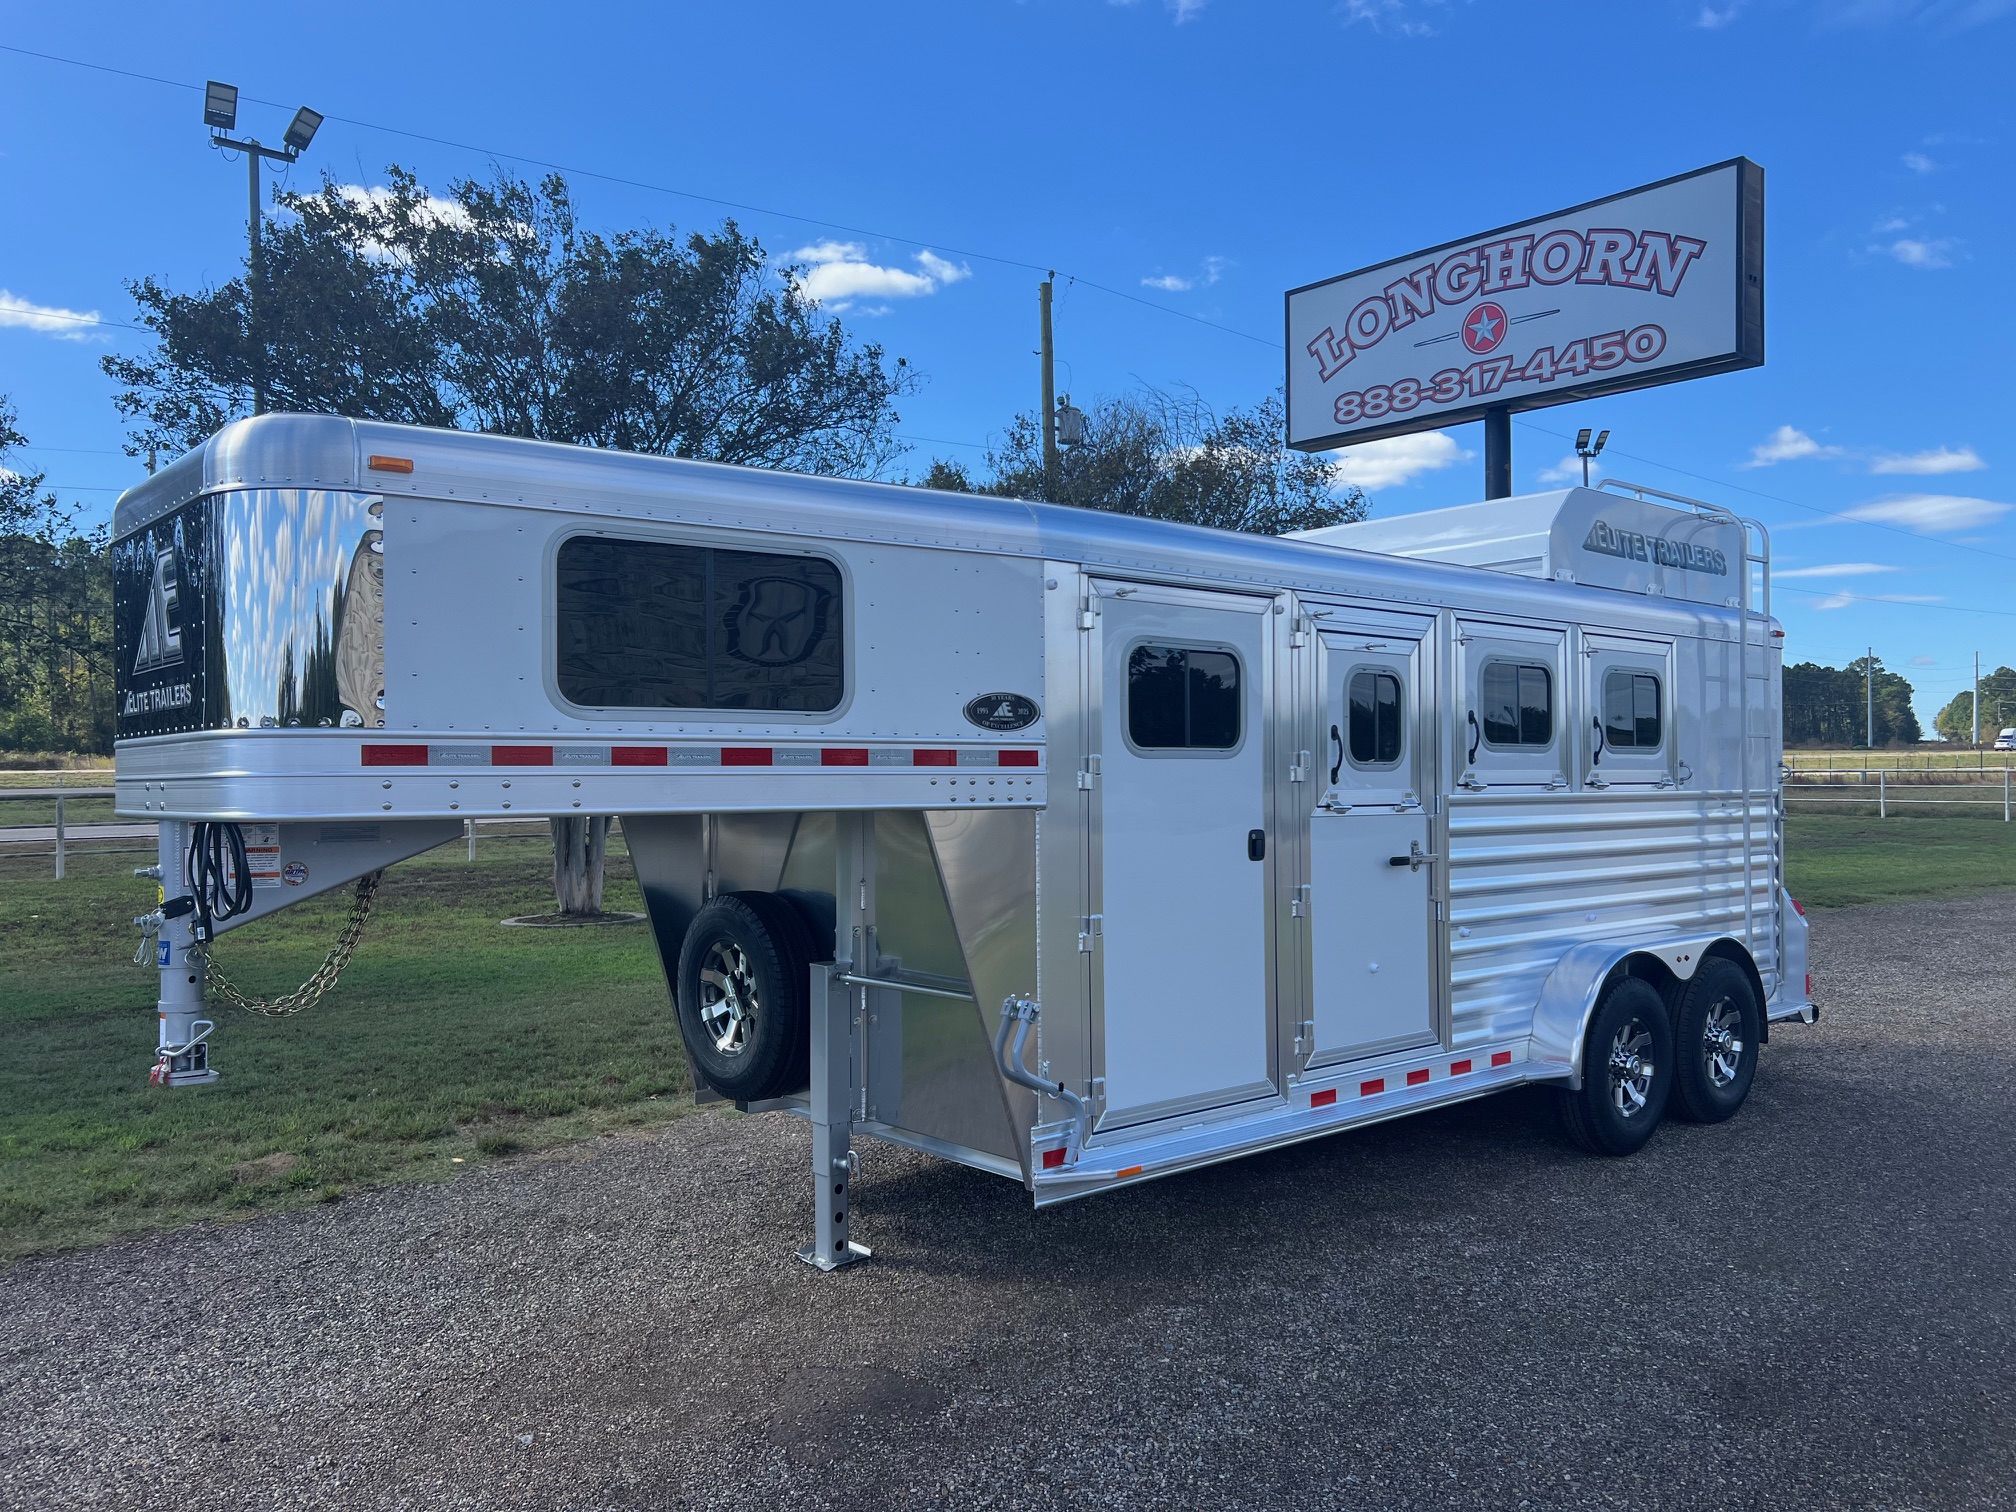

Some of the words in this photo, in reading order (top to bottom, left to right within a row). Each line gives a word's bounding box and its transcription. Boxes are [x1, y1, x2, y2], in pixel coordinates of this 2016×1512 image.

[1307, 228, 1707, 383] LONGHORN
[1334, 324, 1666, 424] 888-317-4450
[1647, 535, 1728, 577] TRAILERS
[150, 682, 192, 712] TRAILERS
